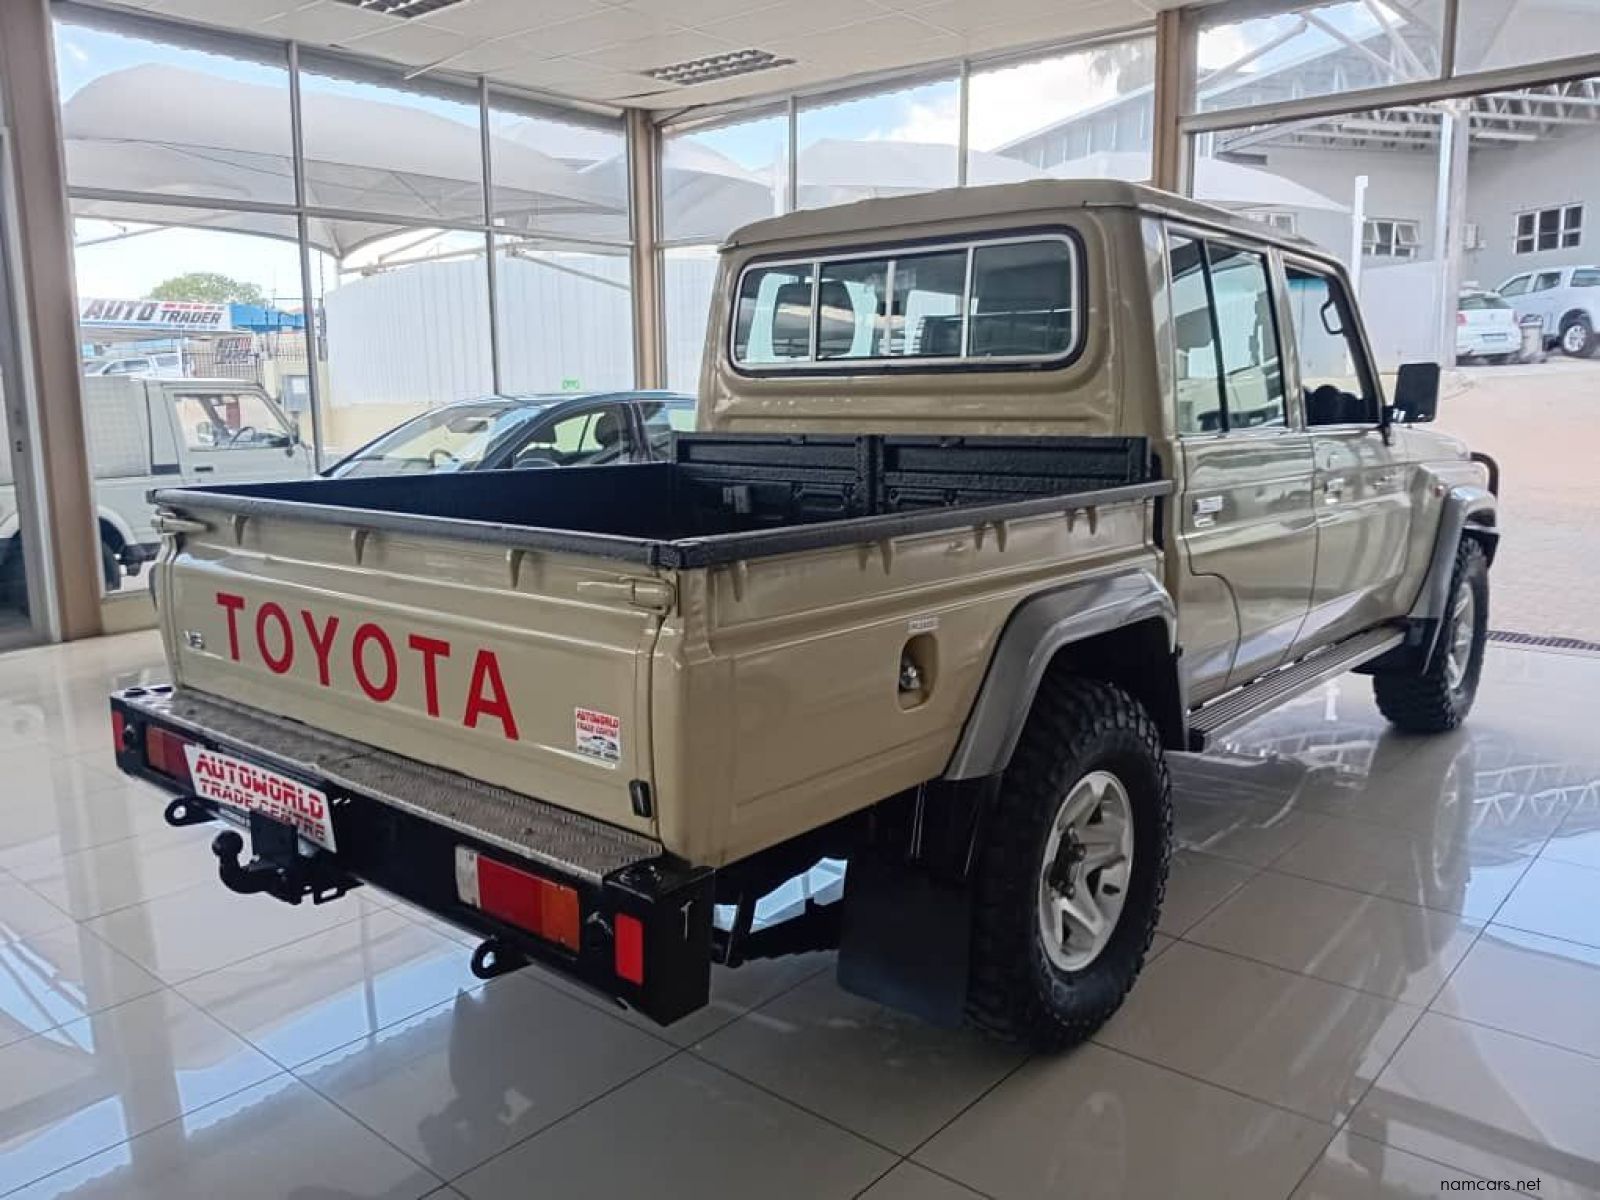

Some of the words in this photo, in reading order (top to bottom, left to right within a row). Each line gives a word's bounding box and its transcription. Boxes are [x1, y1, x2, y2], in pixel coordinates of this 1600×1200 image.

[82, 299, 158, 321] AUTO
[160, 310, 222, 324] TRADER
[216, 592, 519, 740] TOYOTA
[195, 752, 324, 819] AUTOWORLD
[199, 777, 254, 809] TRADE
[258, 799, 326, 842] CENTRE
